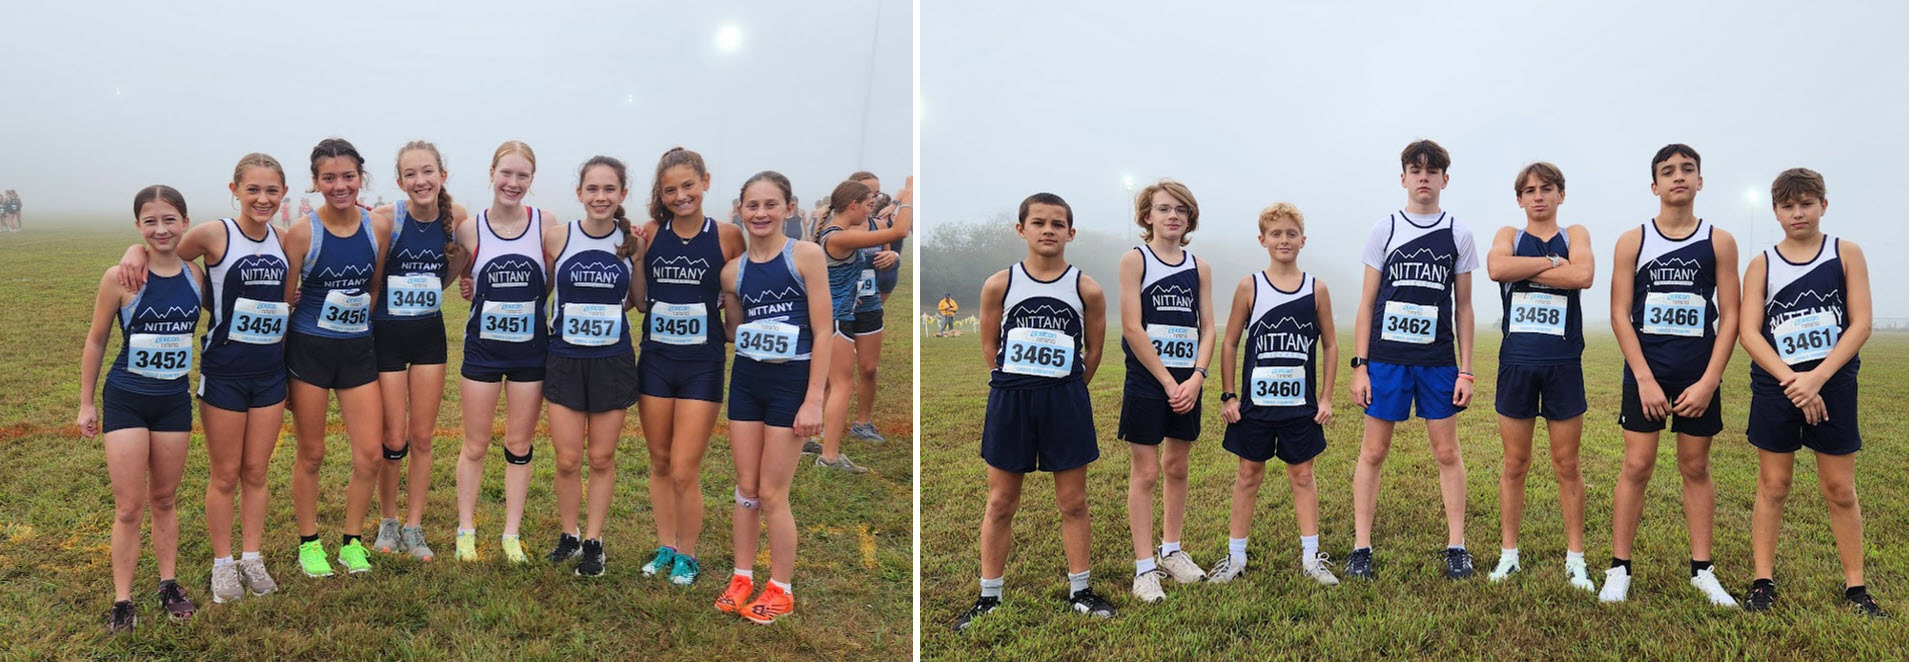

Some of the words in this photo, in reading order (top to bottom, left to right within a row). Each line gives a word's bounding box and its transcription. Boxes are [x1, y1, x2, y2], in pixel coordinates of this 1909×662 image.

[241, 268, 284, 281] NITTANY
[401, 262, 444, 270] NITTANY
[653, 266, 707, 280] NITTANY
[1388, 262, 1451, 284] NITTANY
[1649, 268, 1698, 281] NITTANY
[324, 278, 369, 287] NITTANY
[488, 271, 531, 284] NITTANY
[570, 270, 620, 284] NITTANY
[393, 290, 437, 307] 3449
[1152, 294, 1194, 308] NITTANY
[326, 306, 367, 324] 3456
[748, 301, 794, 317] NITTANY
[1514, 306, 1560, 325] 3458
[1649, 307, 1699, 326] 3466
[144, 321, 195, 331] NITTANY
[237, 315, 282, 334] 3454
[486, 315, 528, 333] 3451
[568, 318, 615, 336] 3457
[655, 316, 700, 336] 3450
[1016, 315, 1070, 330] NITTANY
[1387, 315, 1431, 335] 3462
[740, 331, 789, 354] 3455
[1152, 339, 1194, 359] 3463
[1255, 332, 1314, 354] NITTANY
[1782, 328, 1831, 355] 3461
[135, 350, 187, 369] 3452
[1010, 343, 1066, 367] 3465
[1256, 380, 1301, 397] 3460
